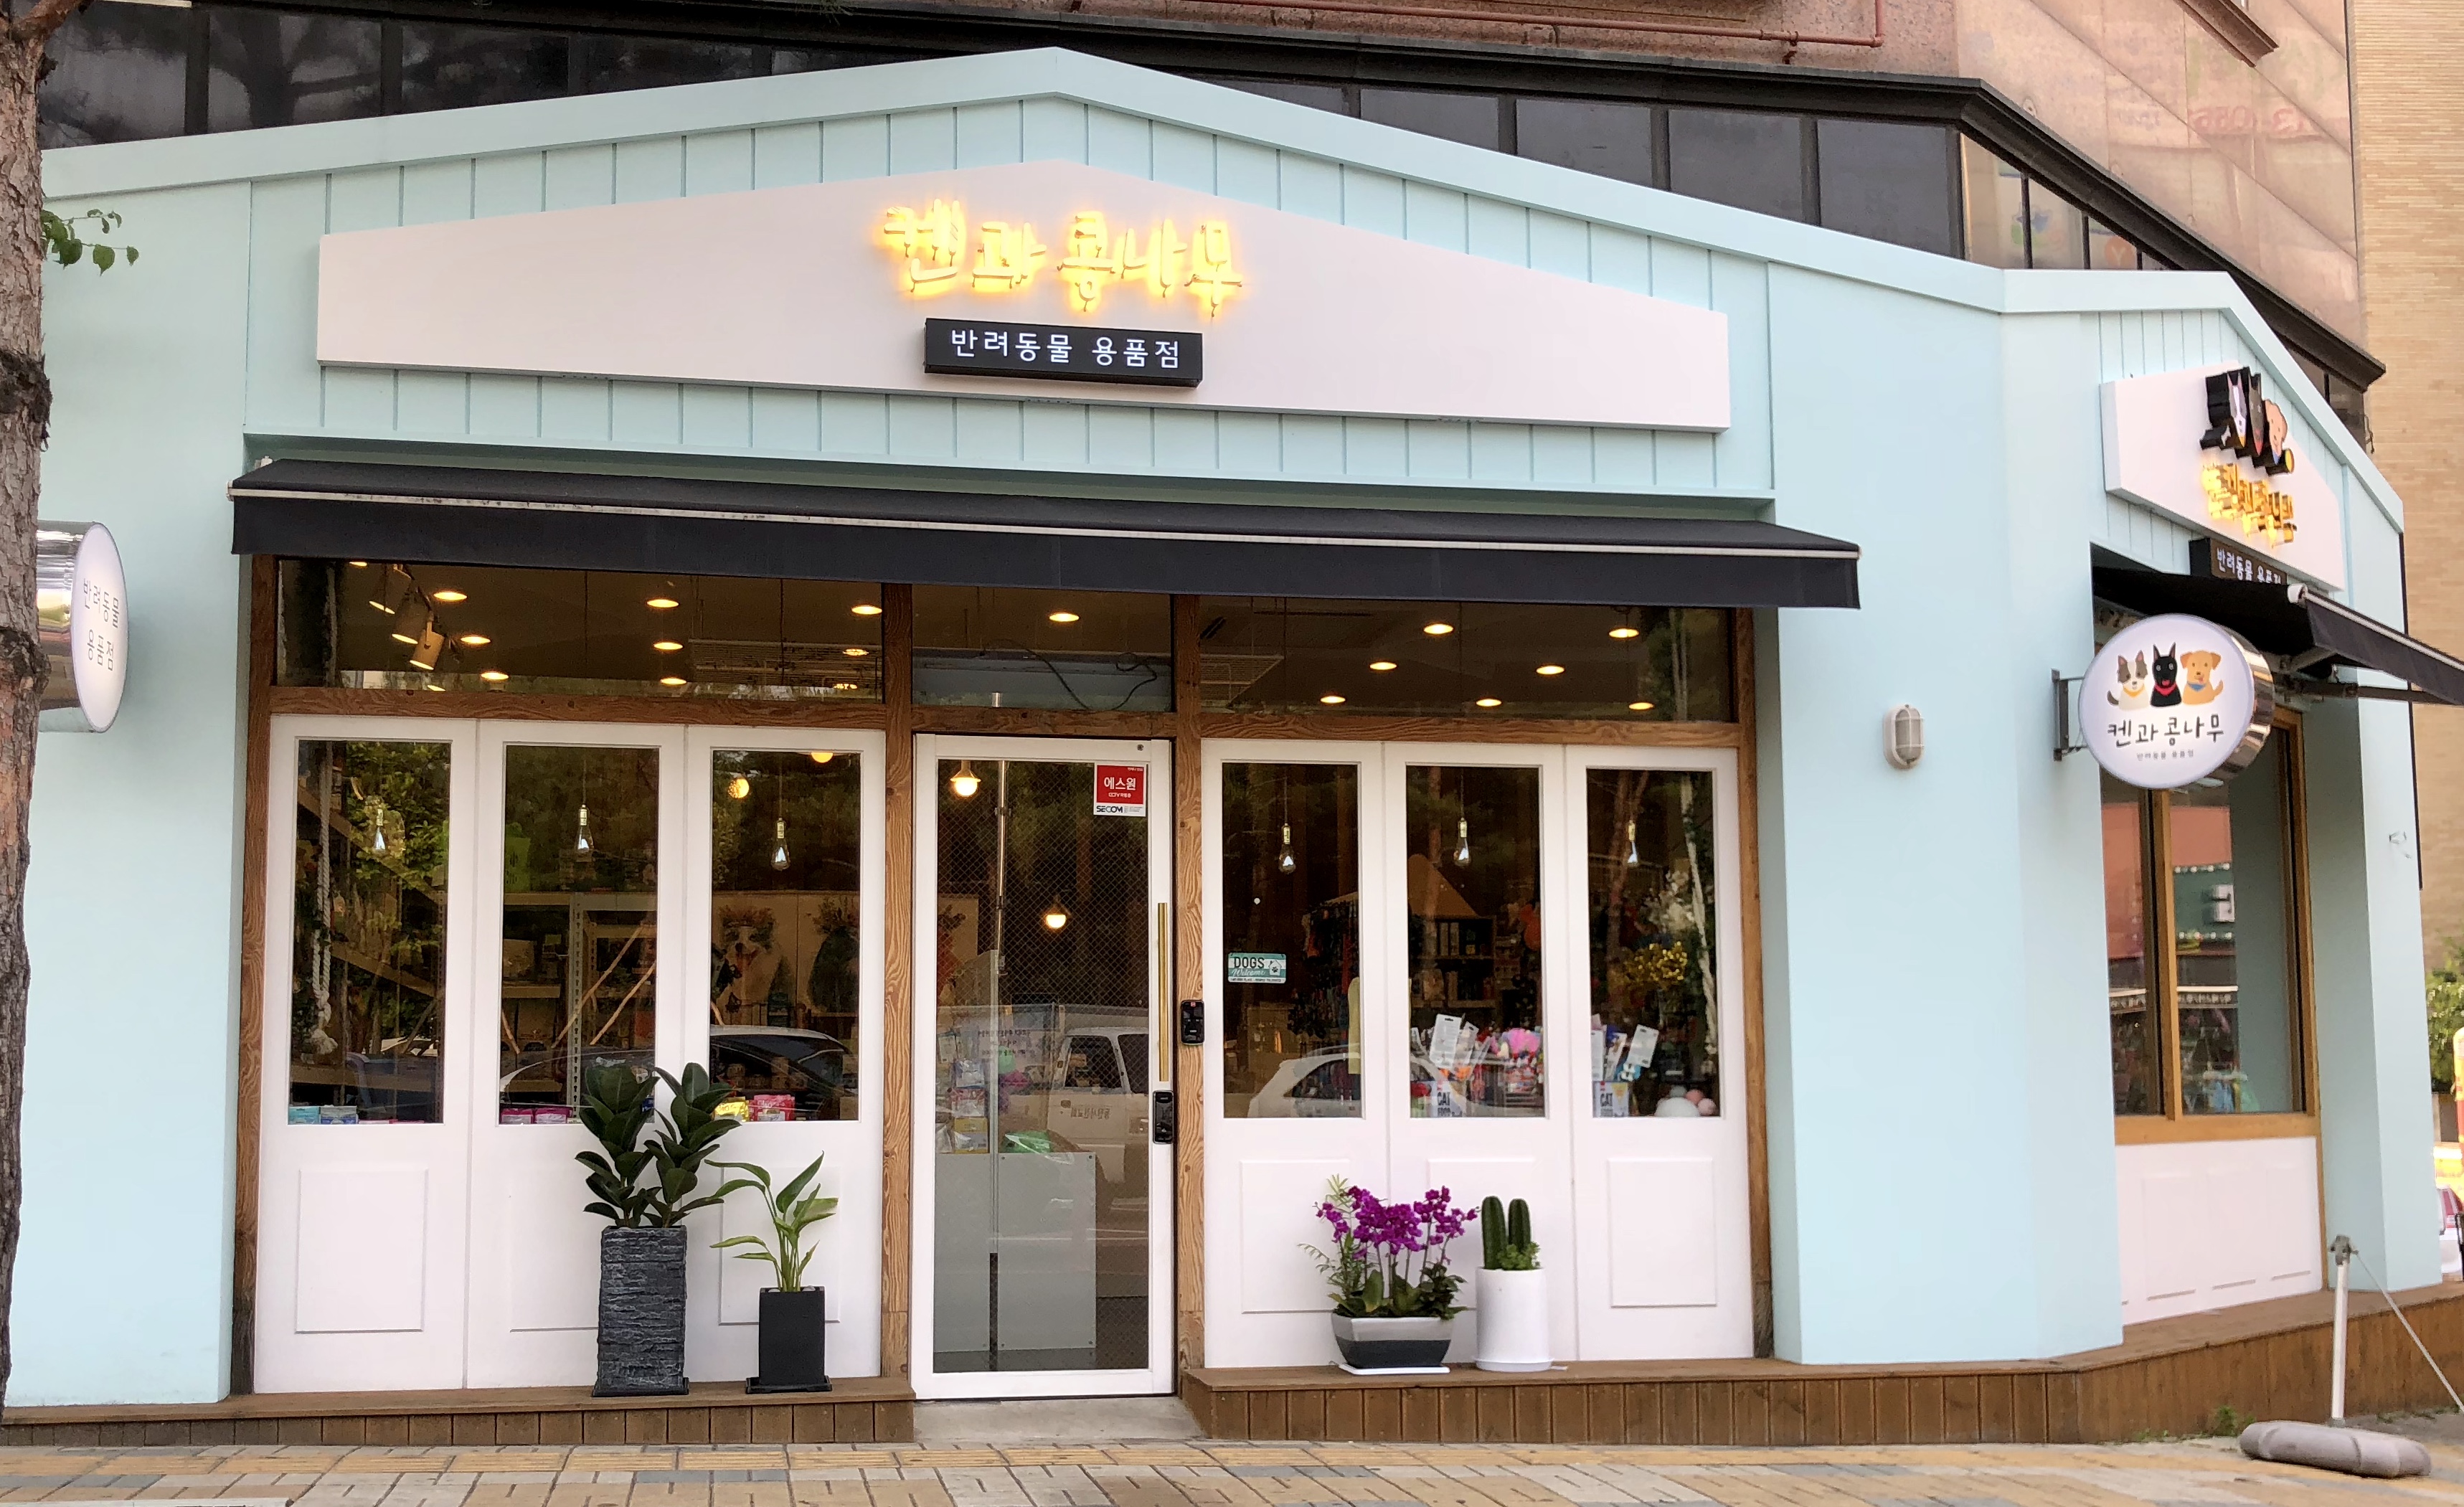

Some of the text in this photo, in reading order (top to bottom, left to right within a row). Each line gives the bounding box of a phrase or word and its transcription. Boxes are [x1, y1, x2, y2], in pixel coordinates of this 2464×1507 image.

[950, 329, 1180, 369] 반려동물 용품점
[2217, 547, 2253, 581] 반려동물
[83, 577, 120, 628] 반려동물
[87, 629, 114, 671] 용품점
[1103, 776, 1136, 791] 에스원
[1096, 805, 1123, 813] SECOM
[1234, 956, 1265, 969] DOGS
[1437, 1091, 1450, 1106] CAT
[1600, 1092, 1613, 1107] CAT
